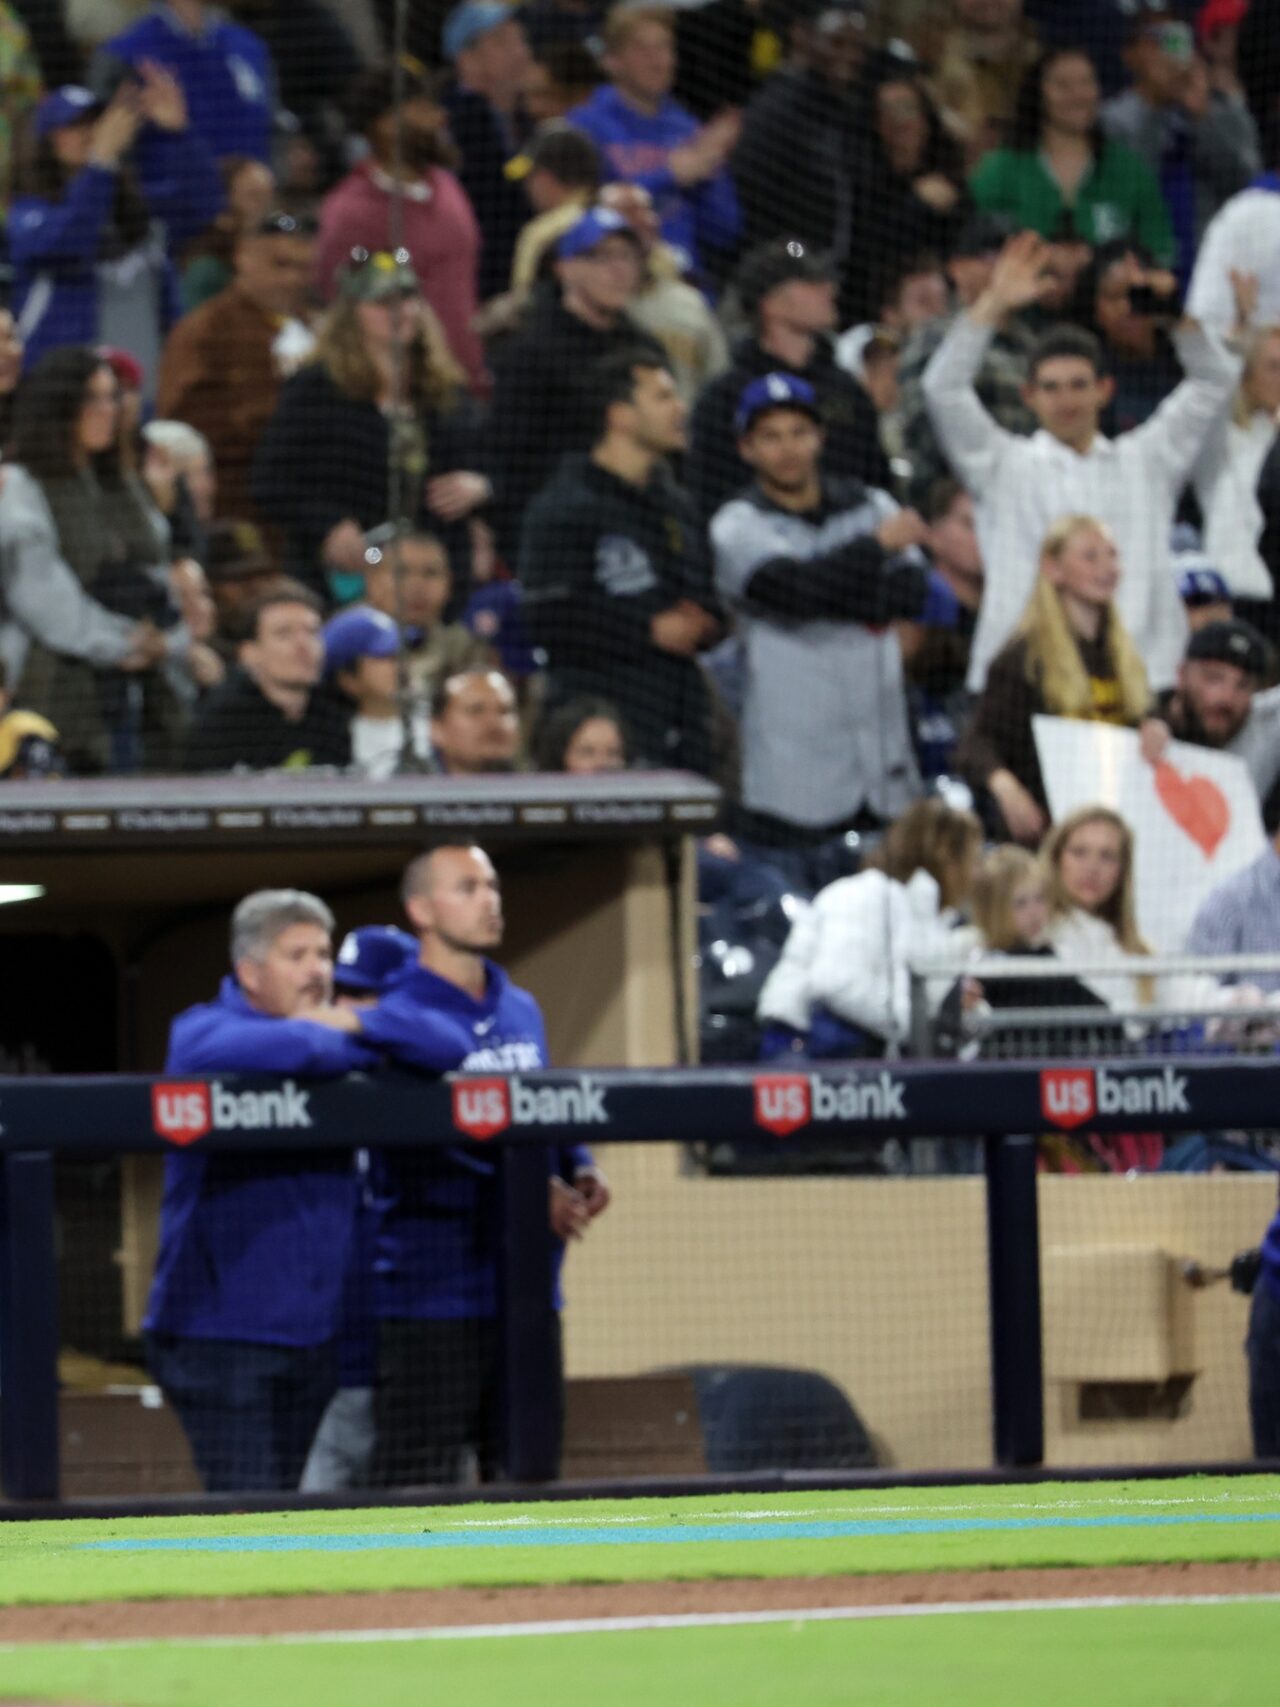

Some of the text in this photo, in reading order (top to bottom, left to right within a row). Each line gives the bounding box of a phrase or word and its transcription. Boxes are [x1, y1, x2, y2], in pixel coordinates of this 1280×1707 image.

[157, 1081, 312, 1130] us bank
[457, 1075, 608, 1124] us bank
[758, 1073, 907, 1120] us bank
[1046, 1067, 1191, 1113] us bank
